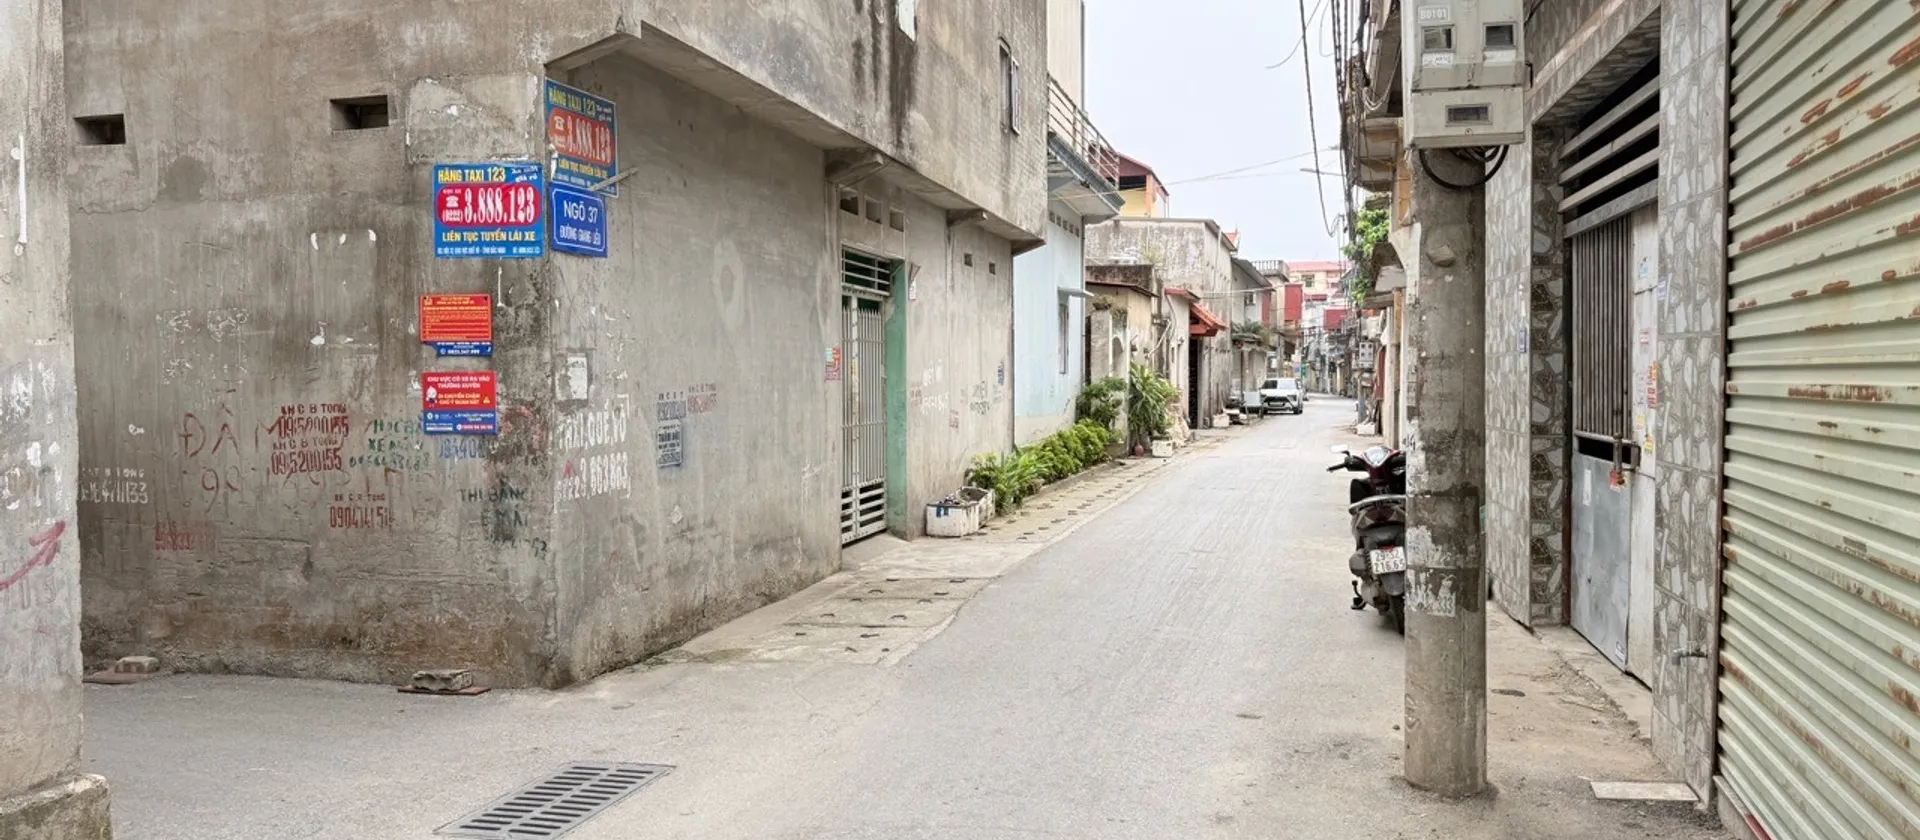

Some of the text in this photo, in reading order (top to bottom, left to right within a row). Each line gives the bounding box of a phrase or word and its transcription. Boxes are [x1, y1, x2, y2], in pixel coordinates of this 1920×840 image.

[583, 97, 596, 118] 123
[464, 169, 484, 183] TAXI
[487, 166, 506, 182] 123
[464, 186, 535, 223] 3.888.123
[563, 199, 598, 224] NGÕ 37
[442, 229, 461, 242] LIÊN
[463, 231, 479, 244] TỤC
[508, 229, 523, 242] LÁI
[524, 231, 536, 242] XE
